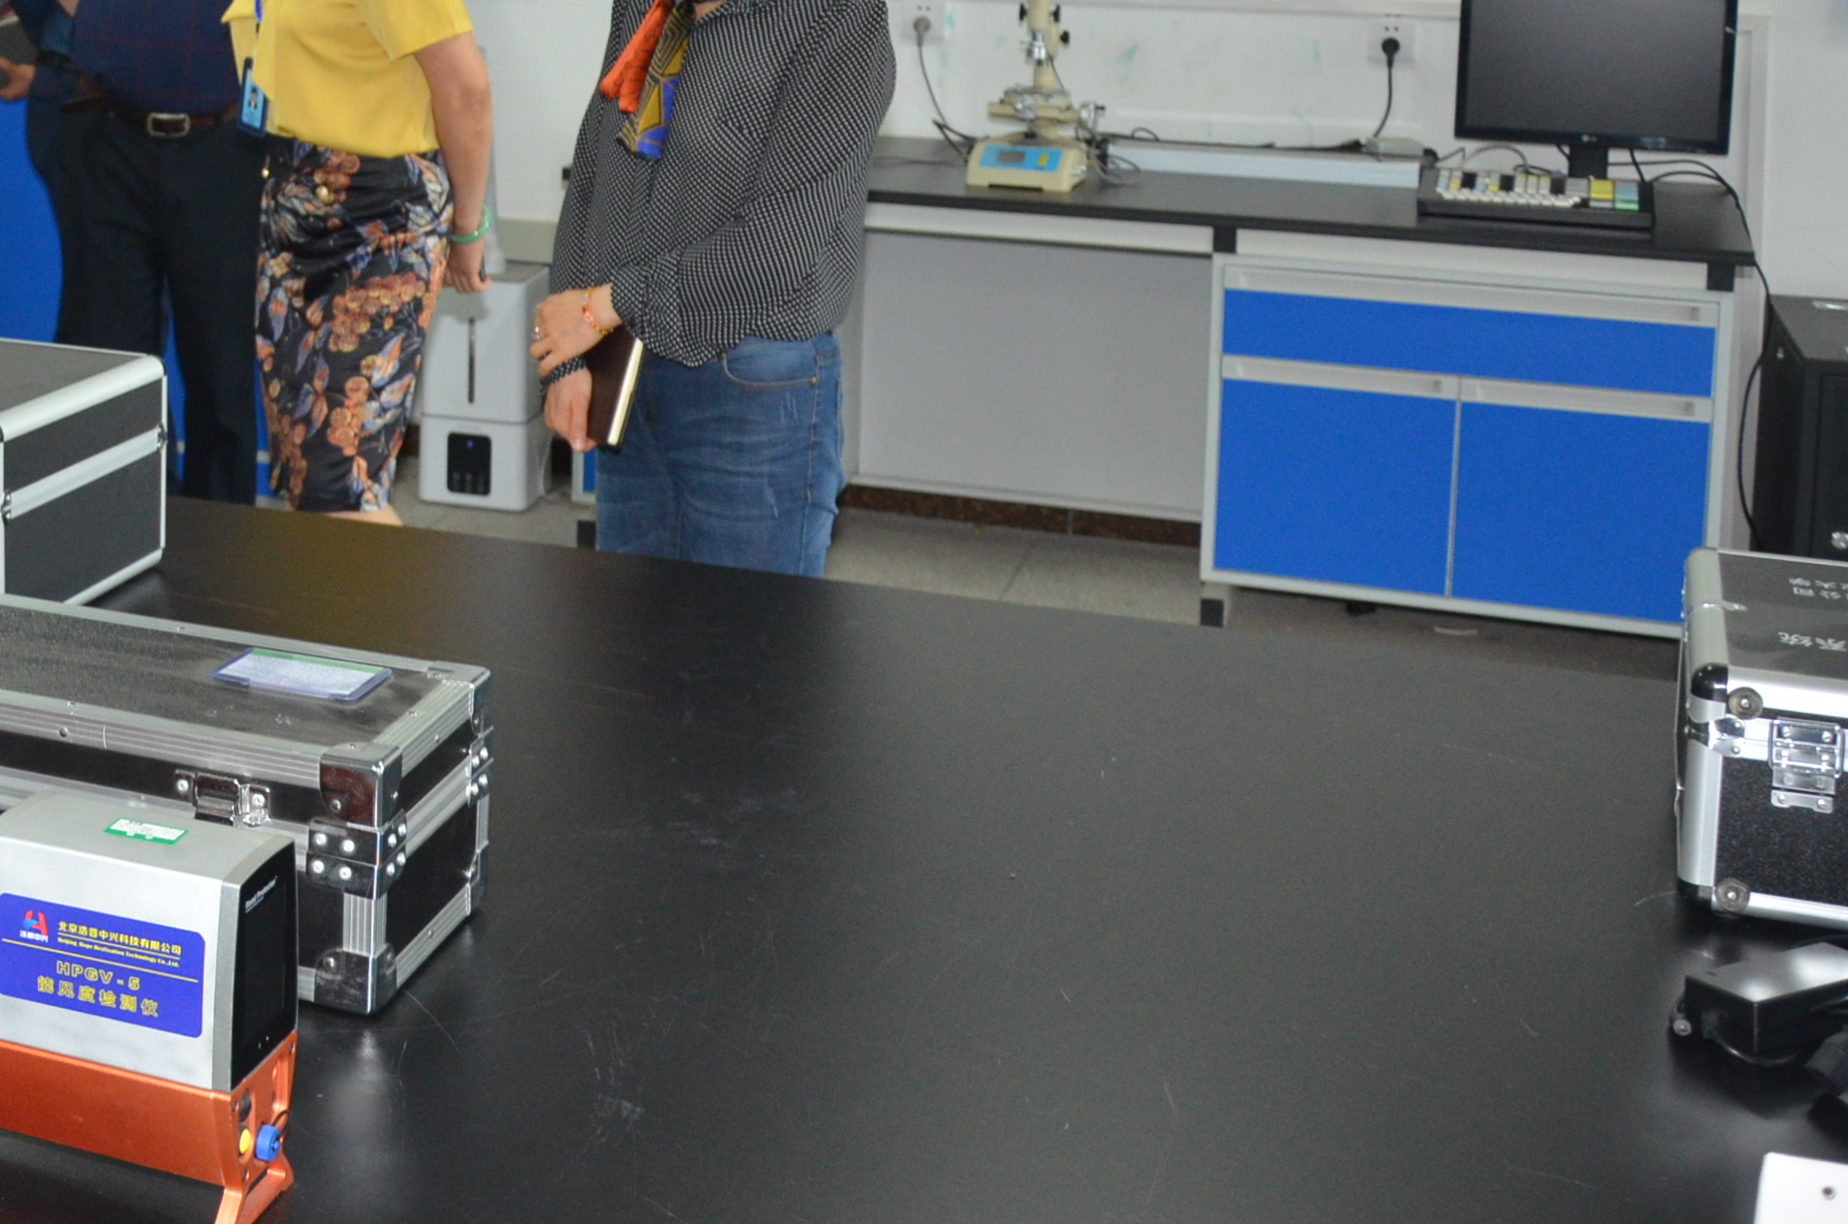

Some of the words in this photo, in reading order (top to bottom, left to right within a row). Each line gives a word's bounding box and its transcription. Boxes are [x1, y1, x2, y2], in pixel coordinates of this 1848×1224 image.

[37, 975, 159, 1018] 能见度检测仪
